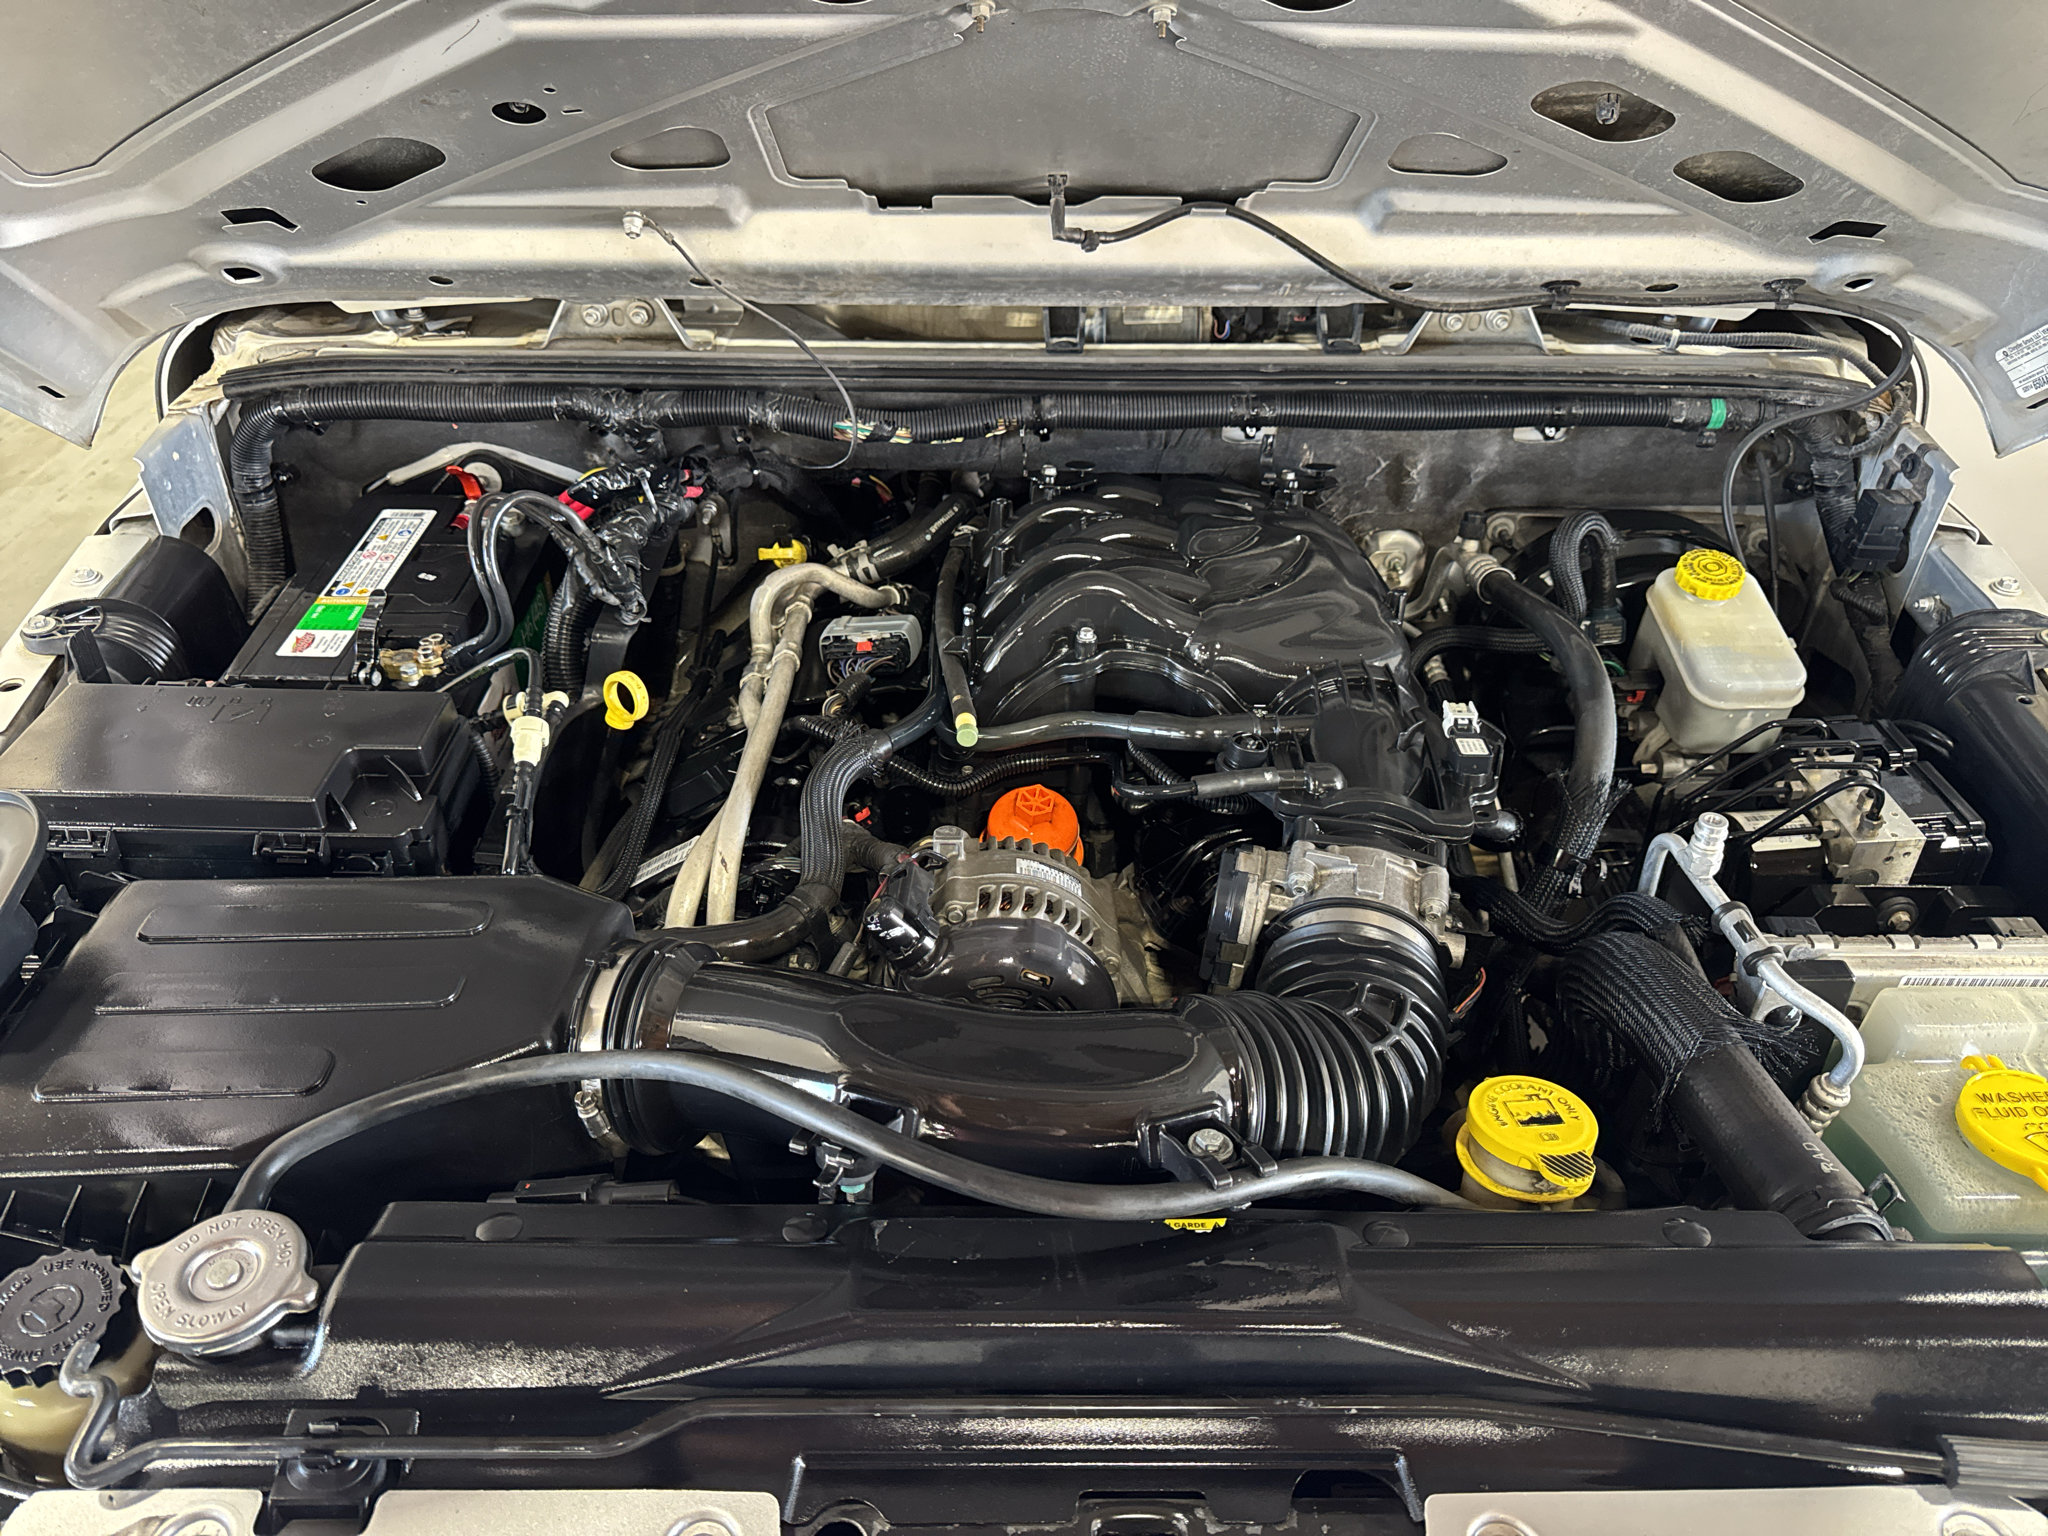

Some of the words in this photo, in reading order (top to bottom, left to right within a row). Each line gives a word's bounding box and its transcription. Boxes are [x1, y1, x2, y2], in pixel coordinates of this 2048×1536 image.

[1493, 1082, 1554, 1097] COOLANT
[1486, 1093, 1508, 1127] ENGINE
[1557, 1097, 1581, 1121] ONLY
[1972, 1106, 2028, 1120] FLUID
[1802, 1142, 1840, 1174] RAD
[175, 1233, 200, 1254] DO
[206, 1216, 242, 1236] NOT
[249, 1216, 287, 1241] OPEN
[275, 1240, 292, 1267] HOT
[43, 1259, 73, 1275] USE
[150, 1282, 176, 1320] OPEN
[174, 1302, 247, 1329] SLOWLY
